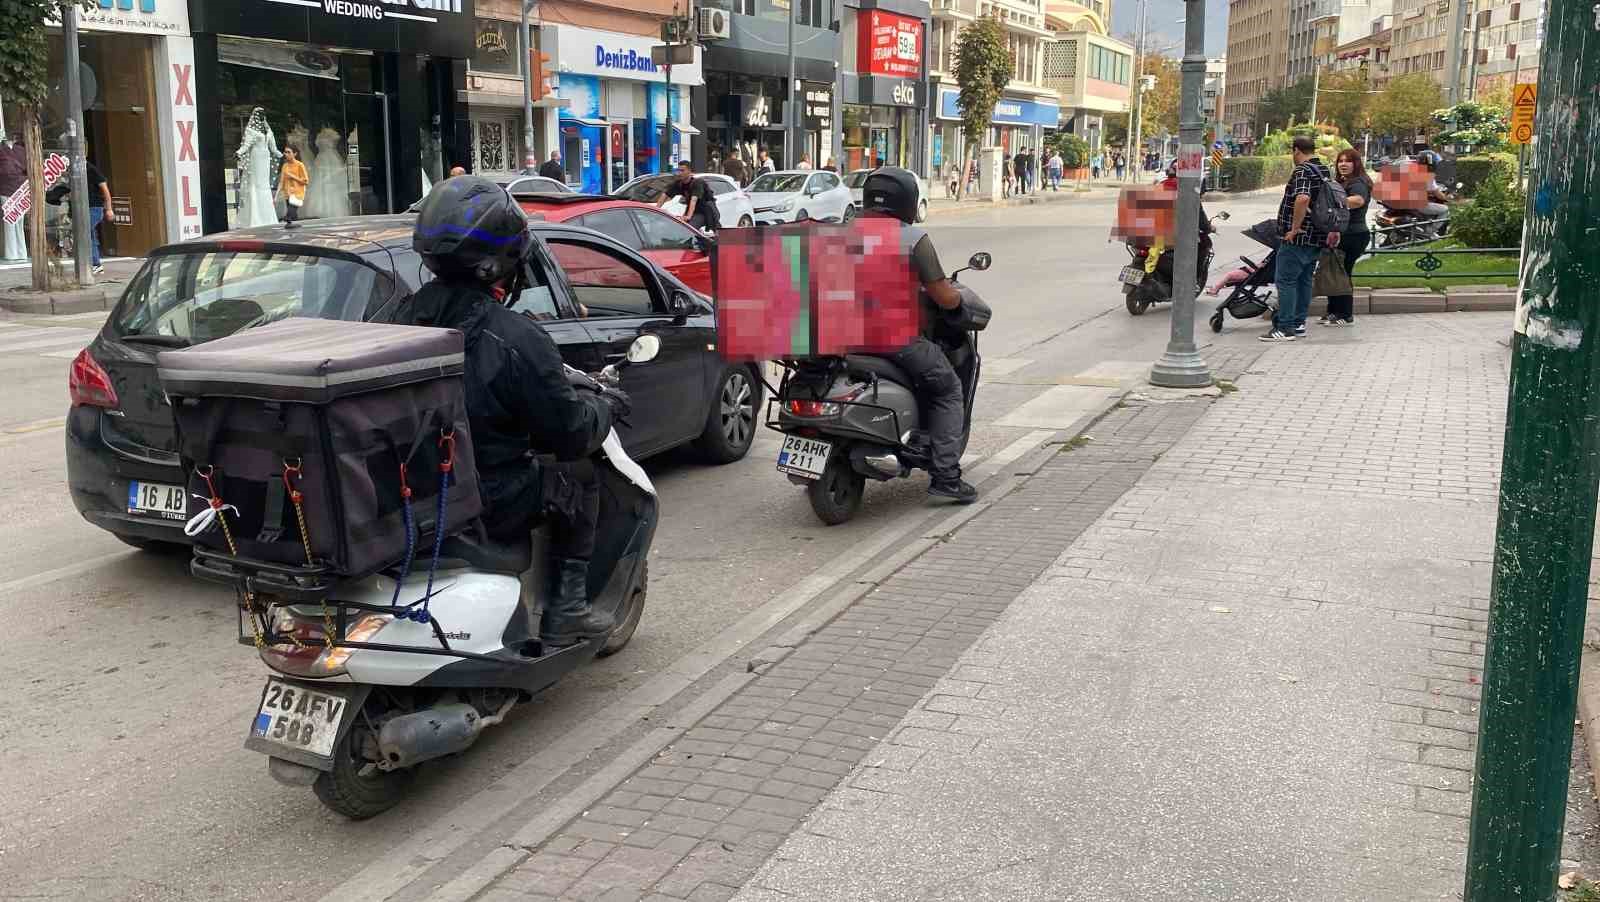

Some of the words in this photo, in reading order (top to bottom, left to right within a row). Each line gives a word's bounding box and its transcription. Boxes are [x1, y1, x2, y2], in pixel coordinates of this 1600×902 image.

[324, 0, 383, 20] WEDDING
[893, 79, 915, 105] eka
[172, 64, 198, 216] XXL
[790, 453, 813, 469] 211
[142, 485, 158, 508] 16
[165, 487, 184, 511] AB
